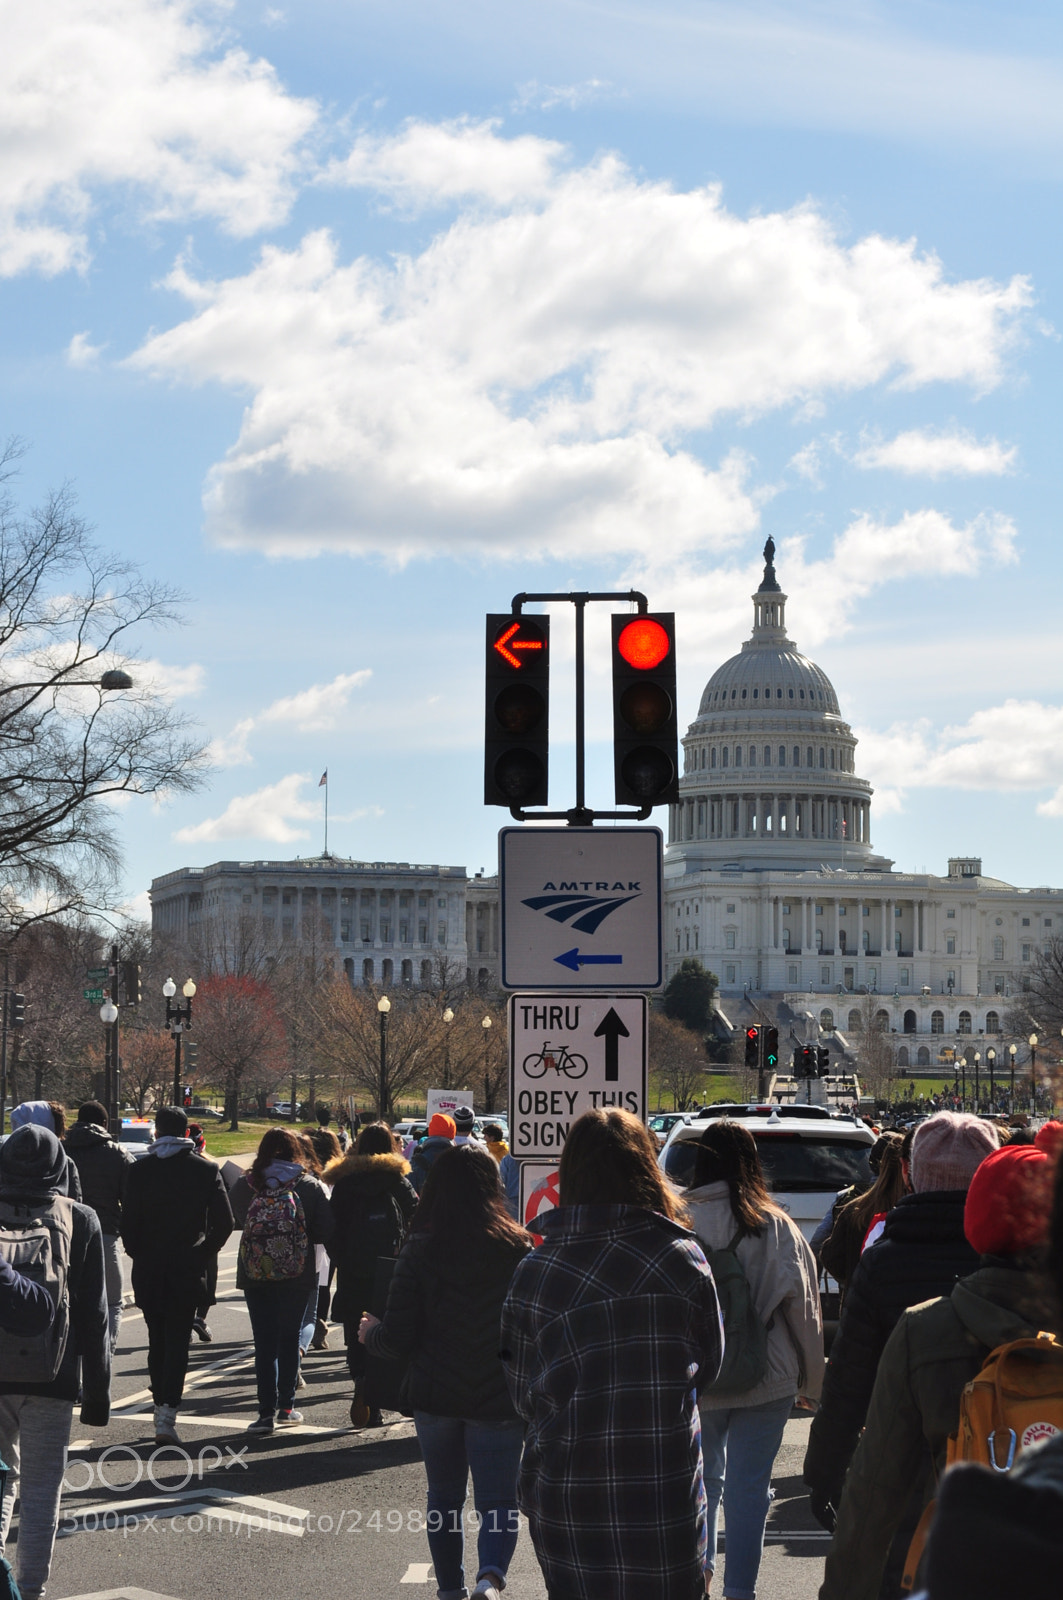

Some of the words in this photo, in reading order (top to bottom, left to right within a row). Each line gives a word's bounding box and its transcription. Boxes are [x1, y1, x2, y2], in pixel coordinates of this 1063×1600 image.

[542, 881, 642, 891] AMTRAK
[519, 1005, 580, 1031] THRU
[518, 1090, 579, 1116] OBEY
[588, 1090, 639, 1115] THIS
